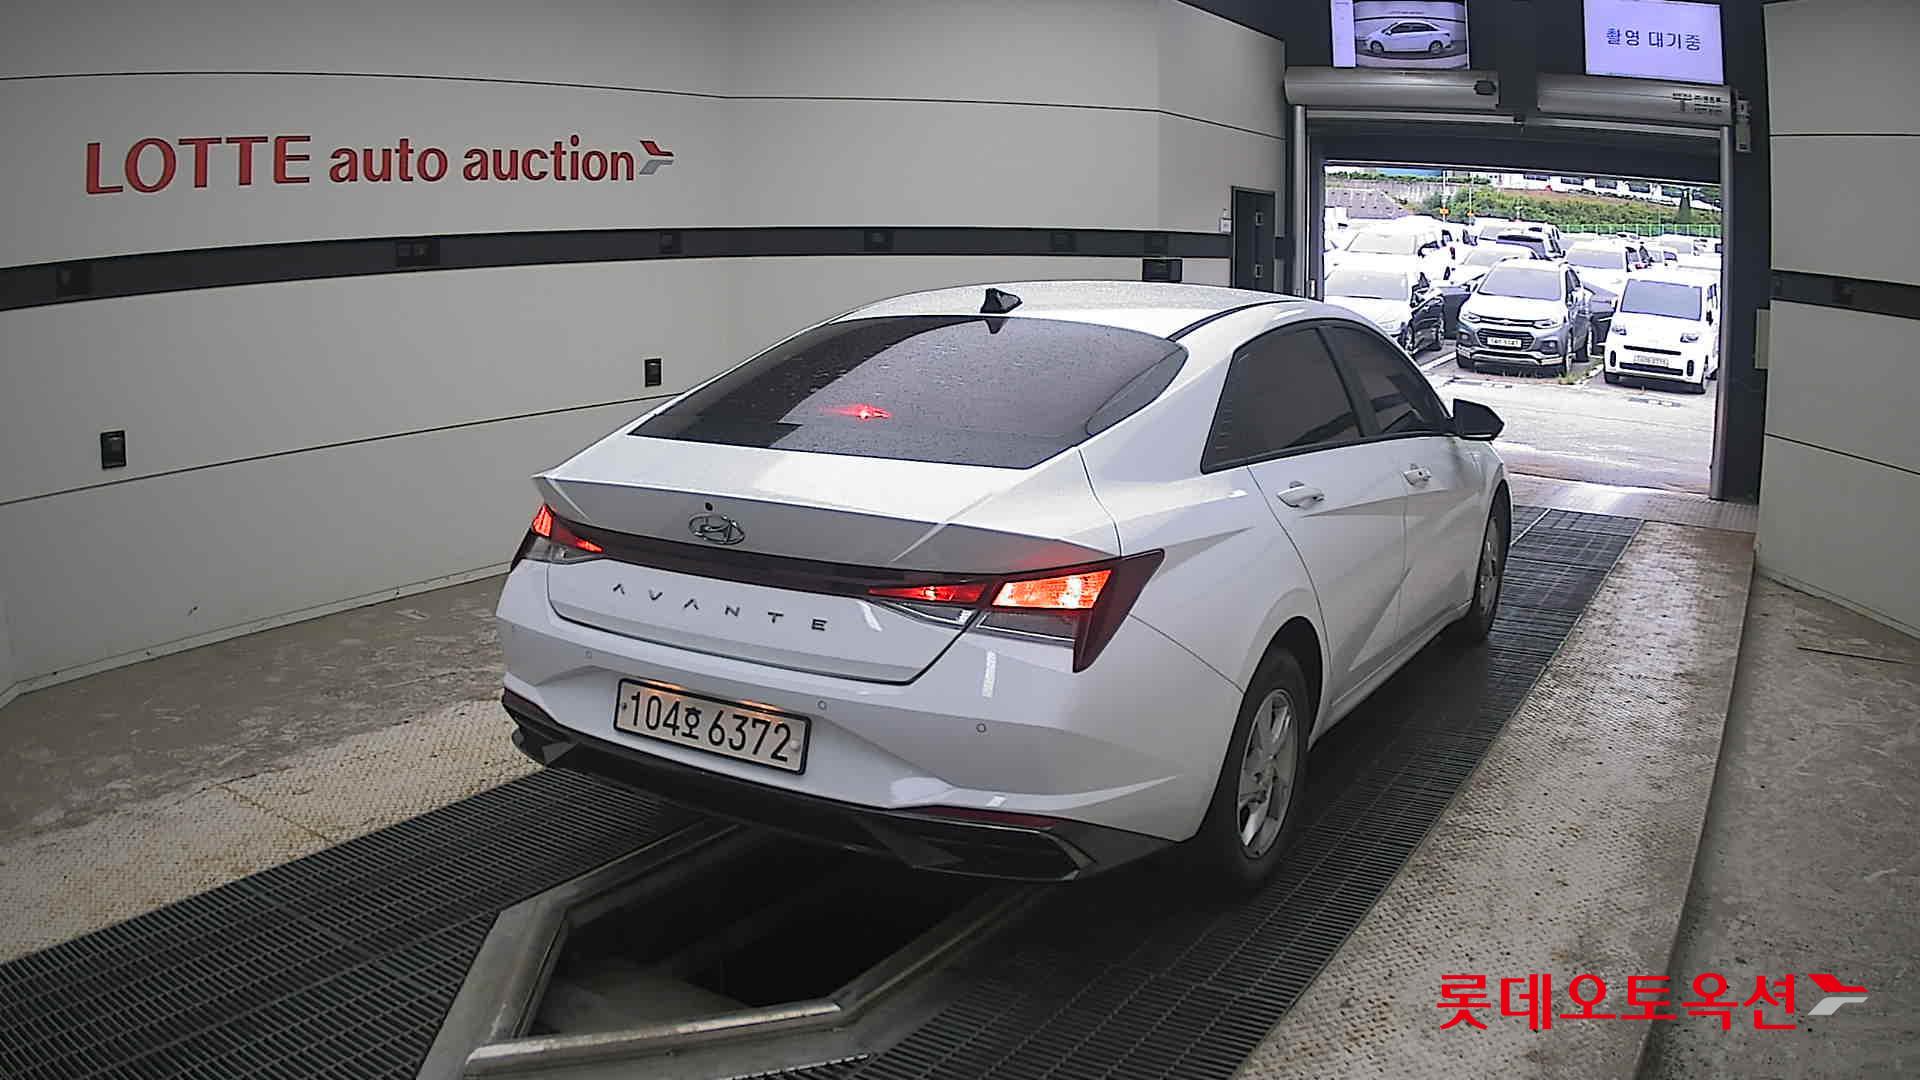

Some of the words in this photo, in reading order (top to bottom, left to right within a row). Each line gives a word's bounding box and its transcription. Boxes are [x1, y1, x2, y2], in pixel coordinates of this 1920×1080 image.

[1606, 27, 1640, 47] 촬영
[1647, 31, 1702, 51] 대기중
[86, 135, 311, 194] LOTTE
[329, 138, 449, 184] auto
[462, 134, 635, 182] auction
[612, 583, 828, 631] AVANTE
